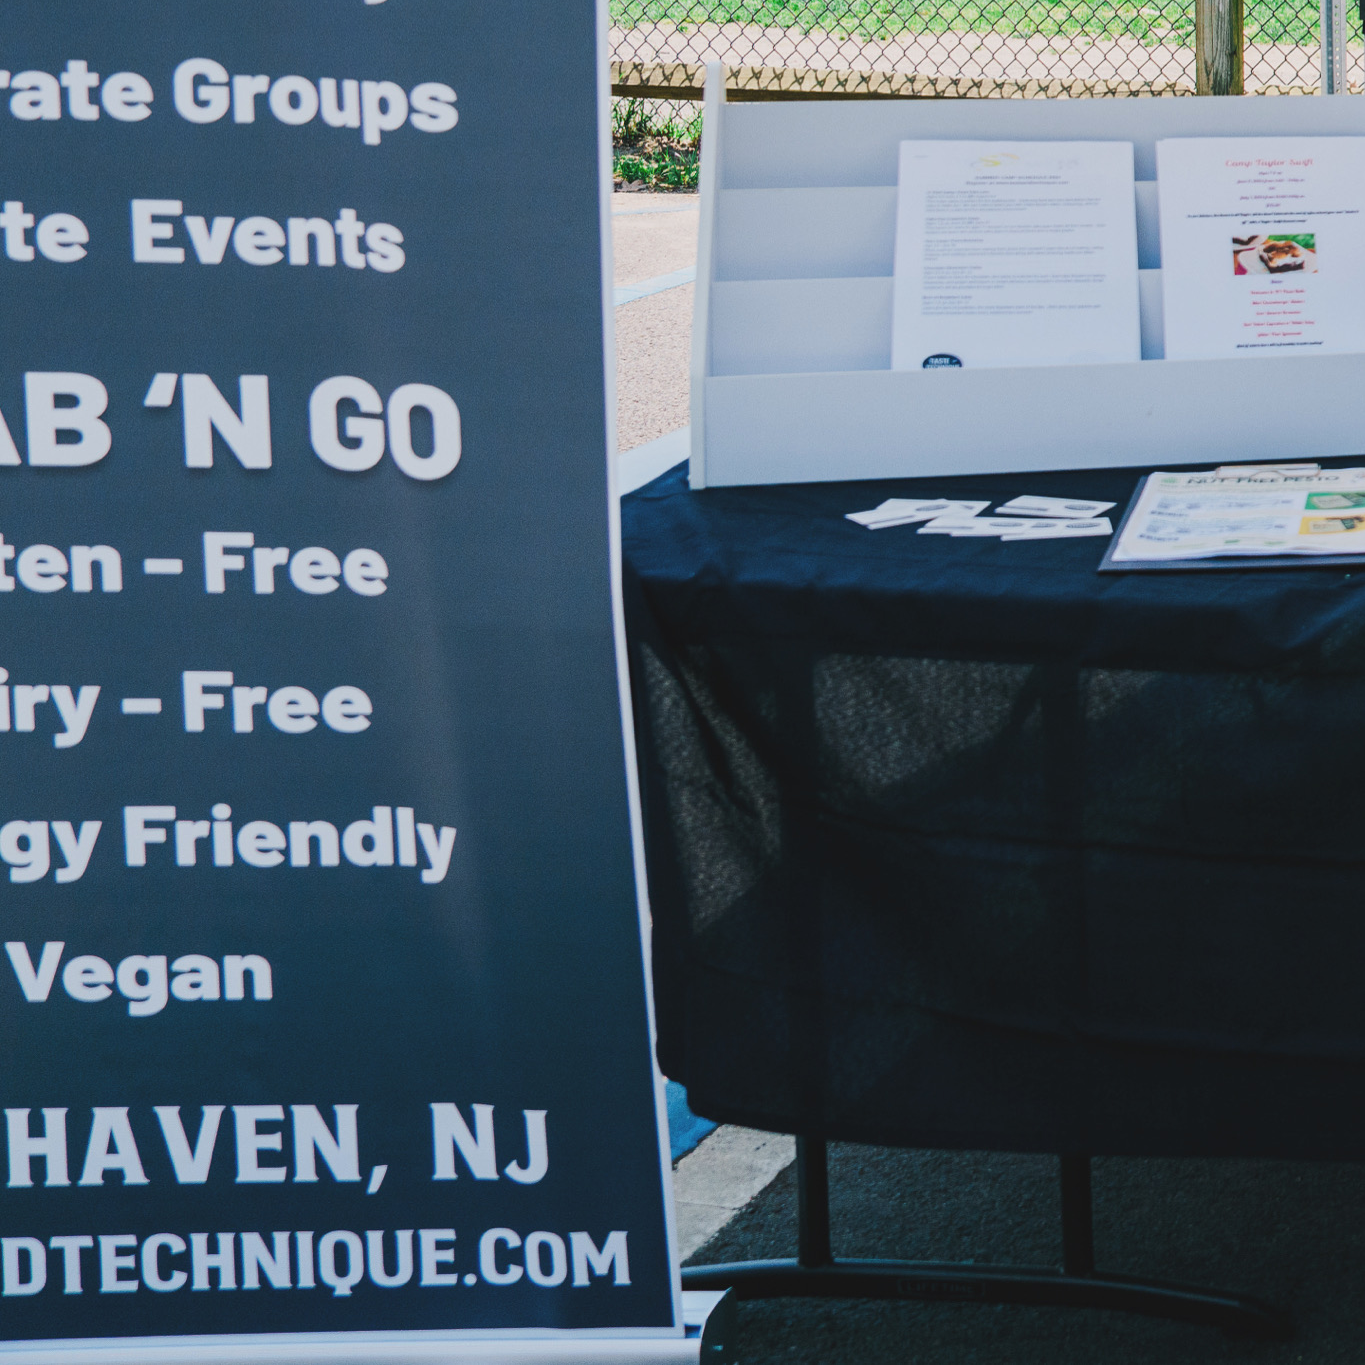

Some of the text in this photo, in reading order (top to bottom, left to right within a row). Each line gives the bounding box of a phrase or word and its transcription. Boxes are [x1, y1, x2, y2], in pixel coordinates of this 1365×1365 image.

[0, 58, 459, 145] ate Groups
[131, 199, 406, 273] Events
[0, 371, 112, 467] B
[308, 376, 463, 481] GO
[203, 531, 389, 597] Free
[183, 670, 374, 734] Free
[123, 803, 457, 884] Friendly
[4, 941, 274, 1017] Vegan
[4, 1101, 550, 1195] HAVEN, NJ
[1, 1226, 632, 1299] DTECHNIQUE.COM
